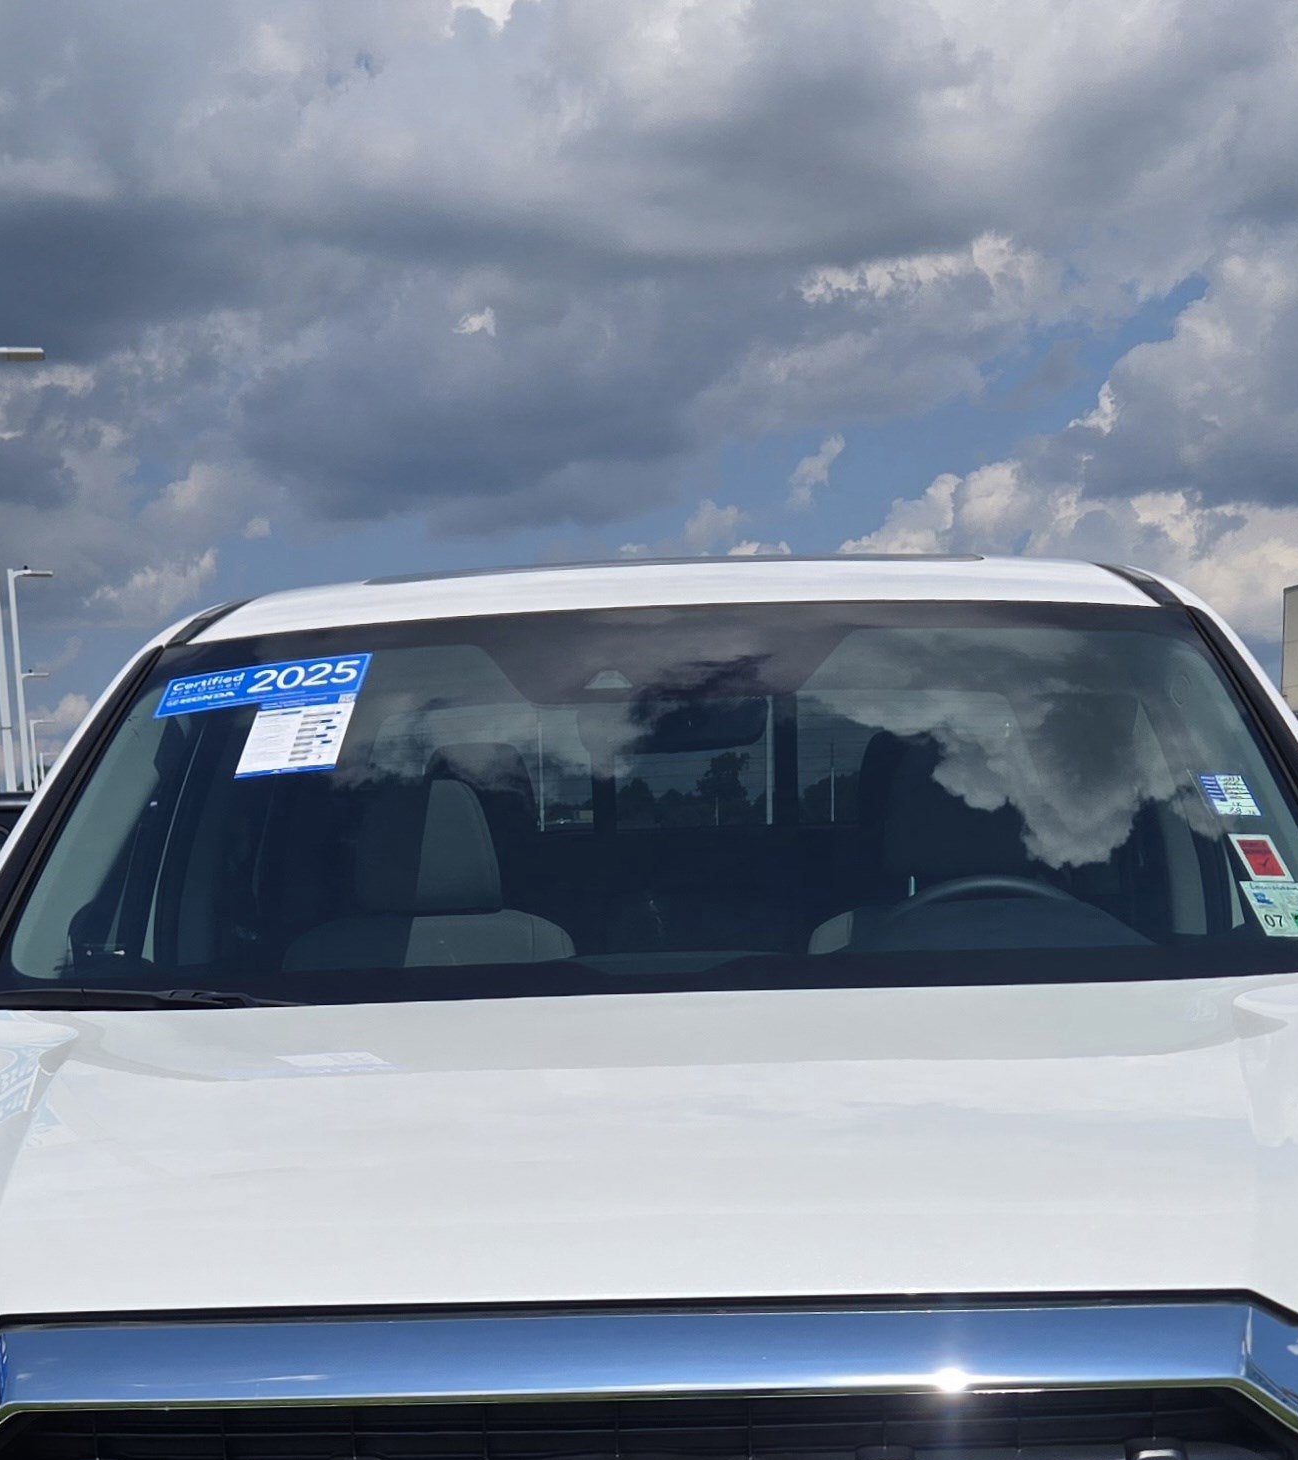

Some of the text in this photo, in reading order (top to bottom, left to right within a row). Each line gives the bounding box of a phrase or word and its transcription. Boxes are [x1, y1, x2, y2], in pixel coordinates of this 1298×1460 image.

[172, 672, 245, 692] Certified
[247, 660, 361, 694] 2025
[179, 691, 235, 704] HONDA
[1264, 914, 1284, 928] 07
